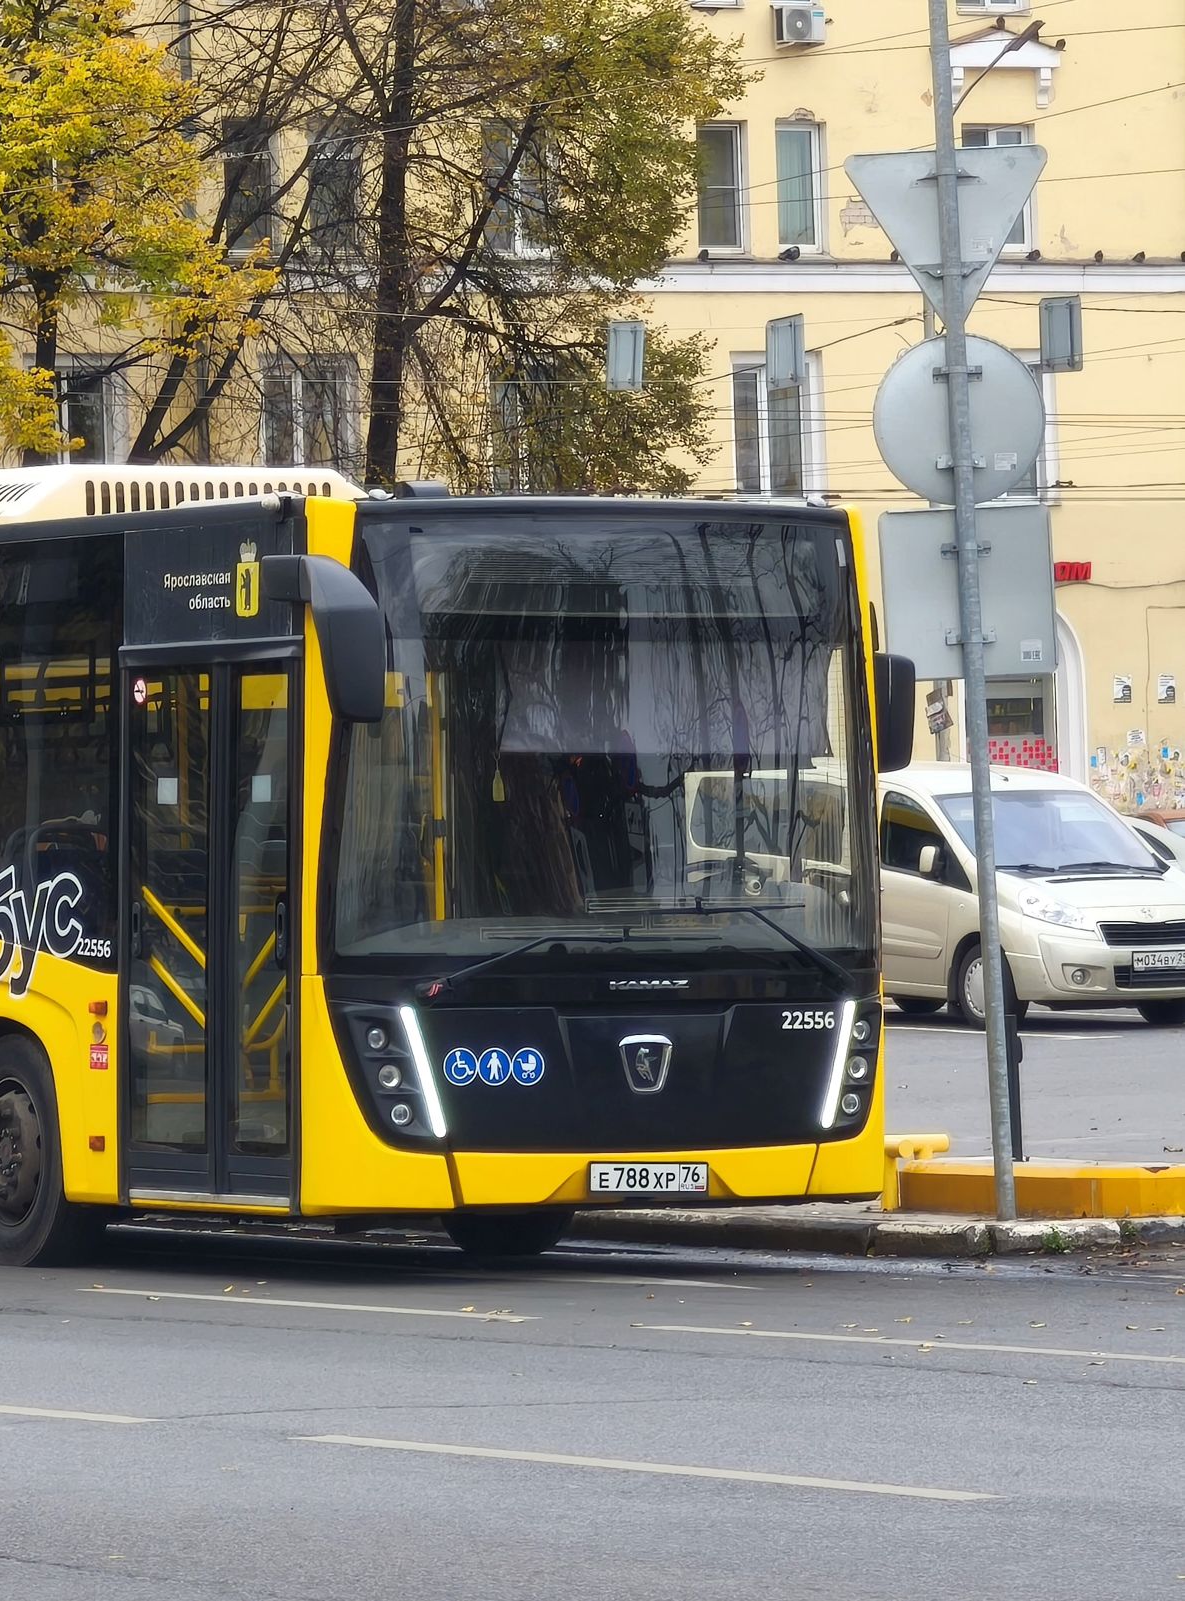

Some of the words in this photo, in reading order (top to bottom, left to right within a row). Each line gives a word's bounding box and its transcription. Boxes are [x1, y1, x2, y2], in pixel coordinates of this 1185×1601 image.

[163, 571, 231, 591] Ярославская
[189, 593, 231, 610] область
[77, 937, 112, 958] 22556
[609, 979, 690, 991] KAMAZ
[781, 1010, 836, 1030] 22556
[681, 1166, 701, 1184] 76
